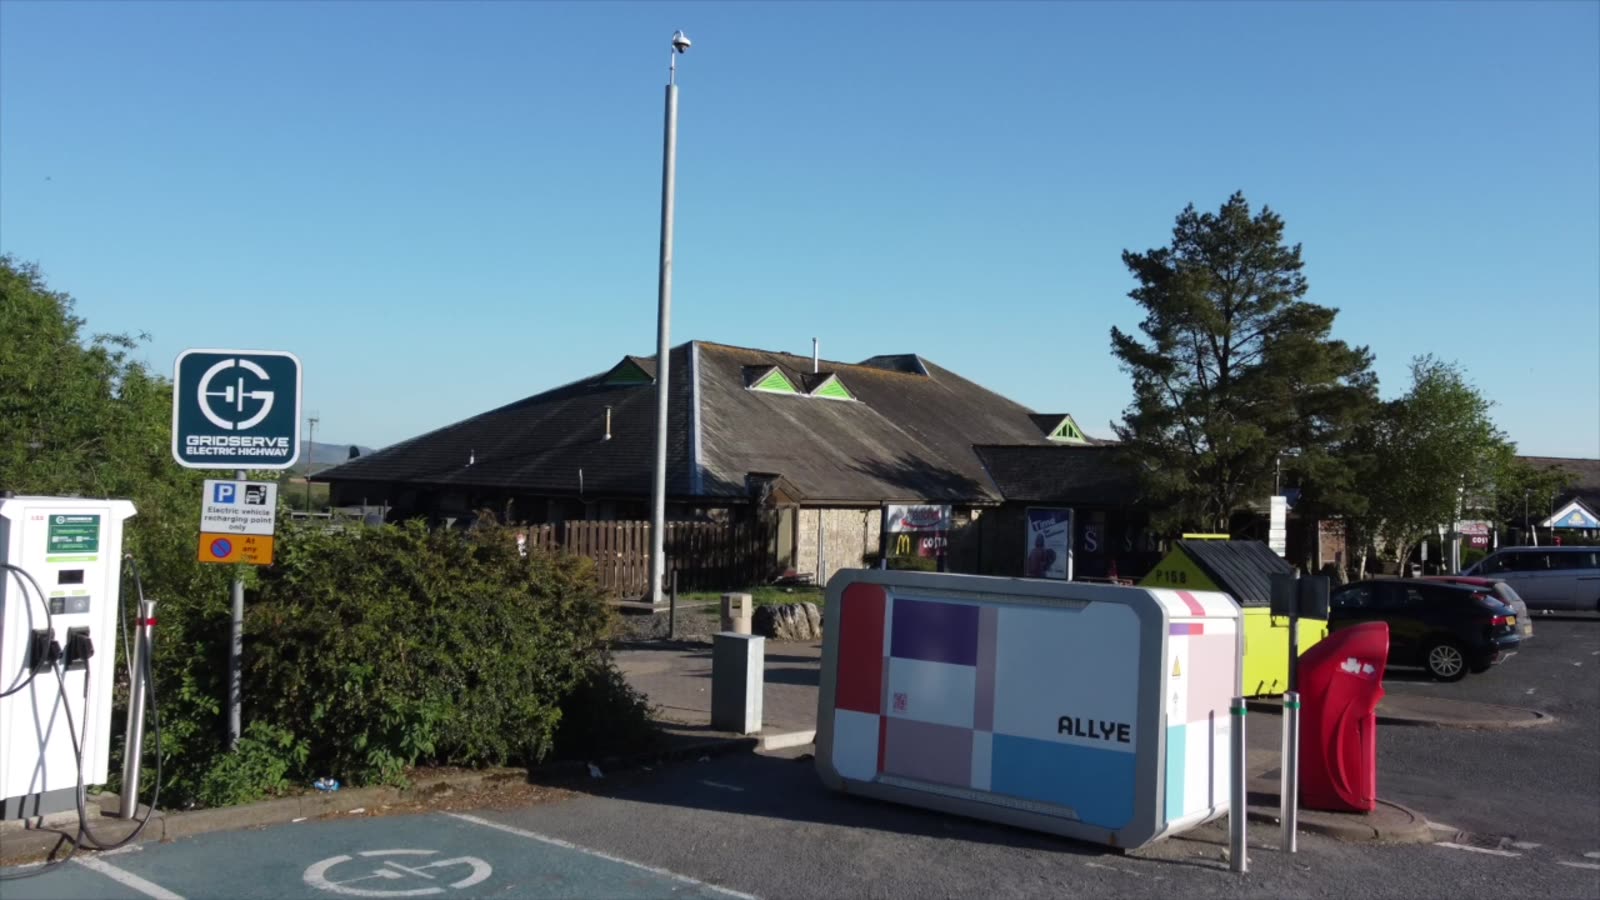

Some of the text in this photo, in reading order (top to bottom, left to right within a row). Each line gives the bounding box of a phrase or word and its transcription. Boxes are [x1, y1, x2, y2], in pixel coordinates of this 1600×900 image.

[186, 435, 289, 447] GRIDSERVE
[186, 447, 288, 457] ELECTRIC HIGHWAY
[218, 485, 233, 502] P
[207, 506, 270, 516] Electric vehicle
[204, 516, 248, 524] recharging
[923, 536, 948, 549] COSTA
[1058, 716, 1131, 743] ALLYE
